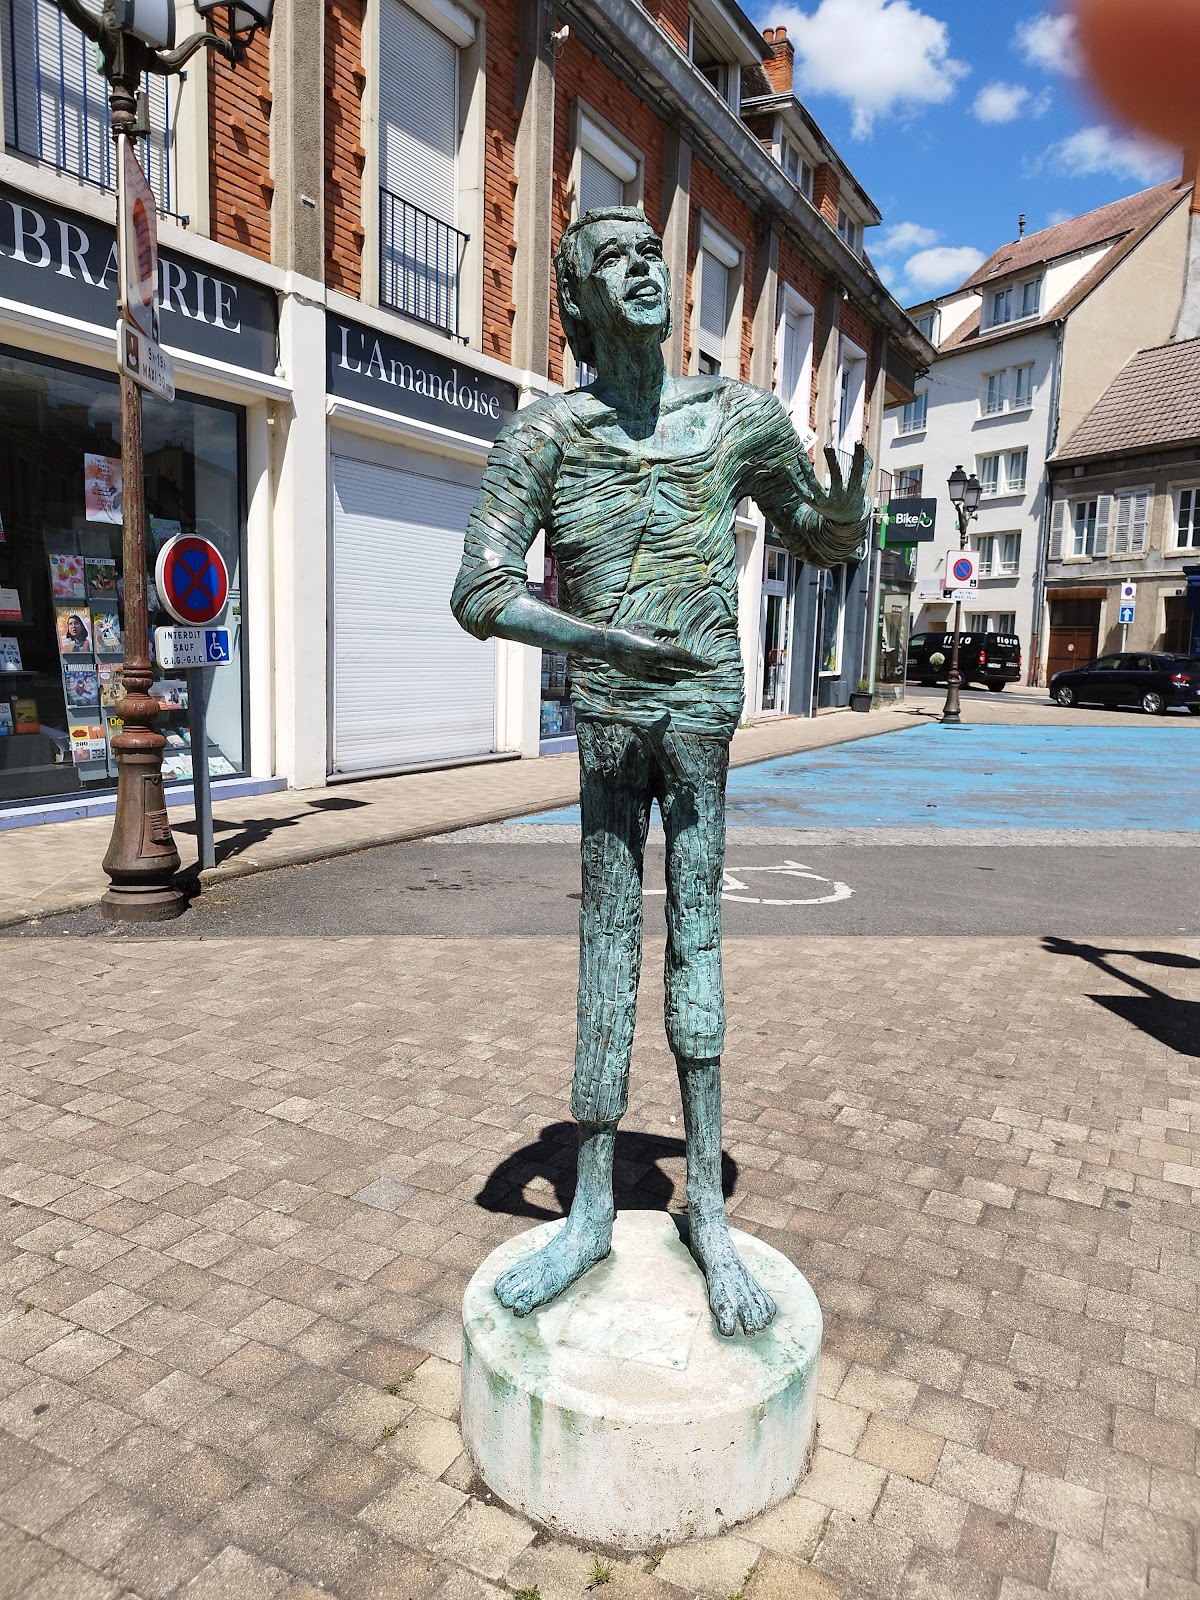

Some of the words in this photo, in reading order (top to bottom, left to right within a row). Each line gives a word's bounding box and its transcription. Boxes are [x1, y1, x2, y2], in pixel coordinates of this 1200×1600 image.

[0, 198, 241, 334] BRARIE
[338, 325, 500, 420] L'Amandoise
[889, 512, 918, 524] eBike
[164, 631, 201, 640] INTERDIT
[943, 635, 972, 645] flra
[173, 643, 194, 652] SAUF
[163, 655, 206, 665] G.I.G.-G.I.C.
